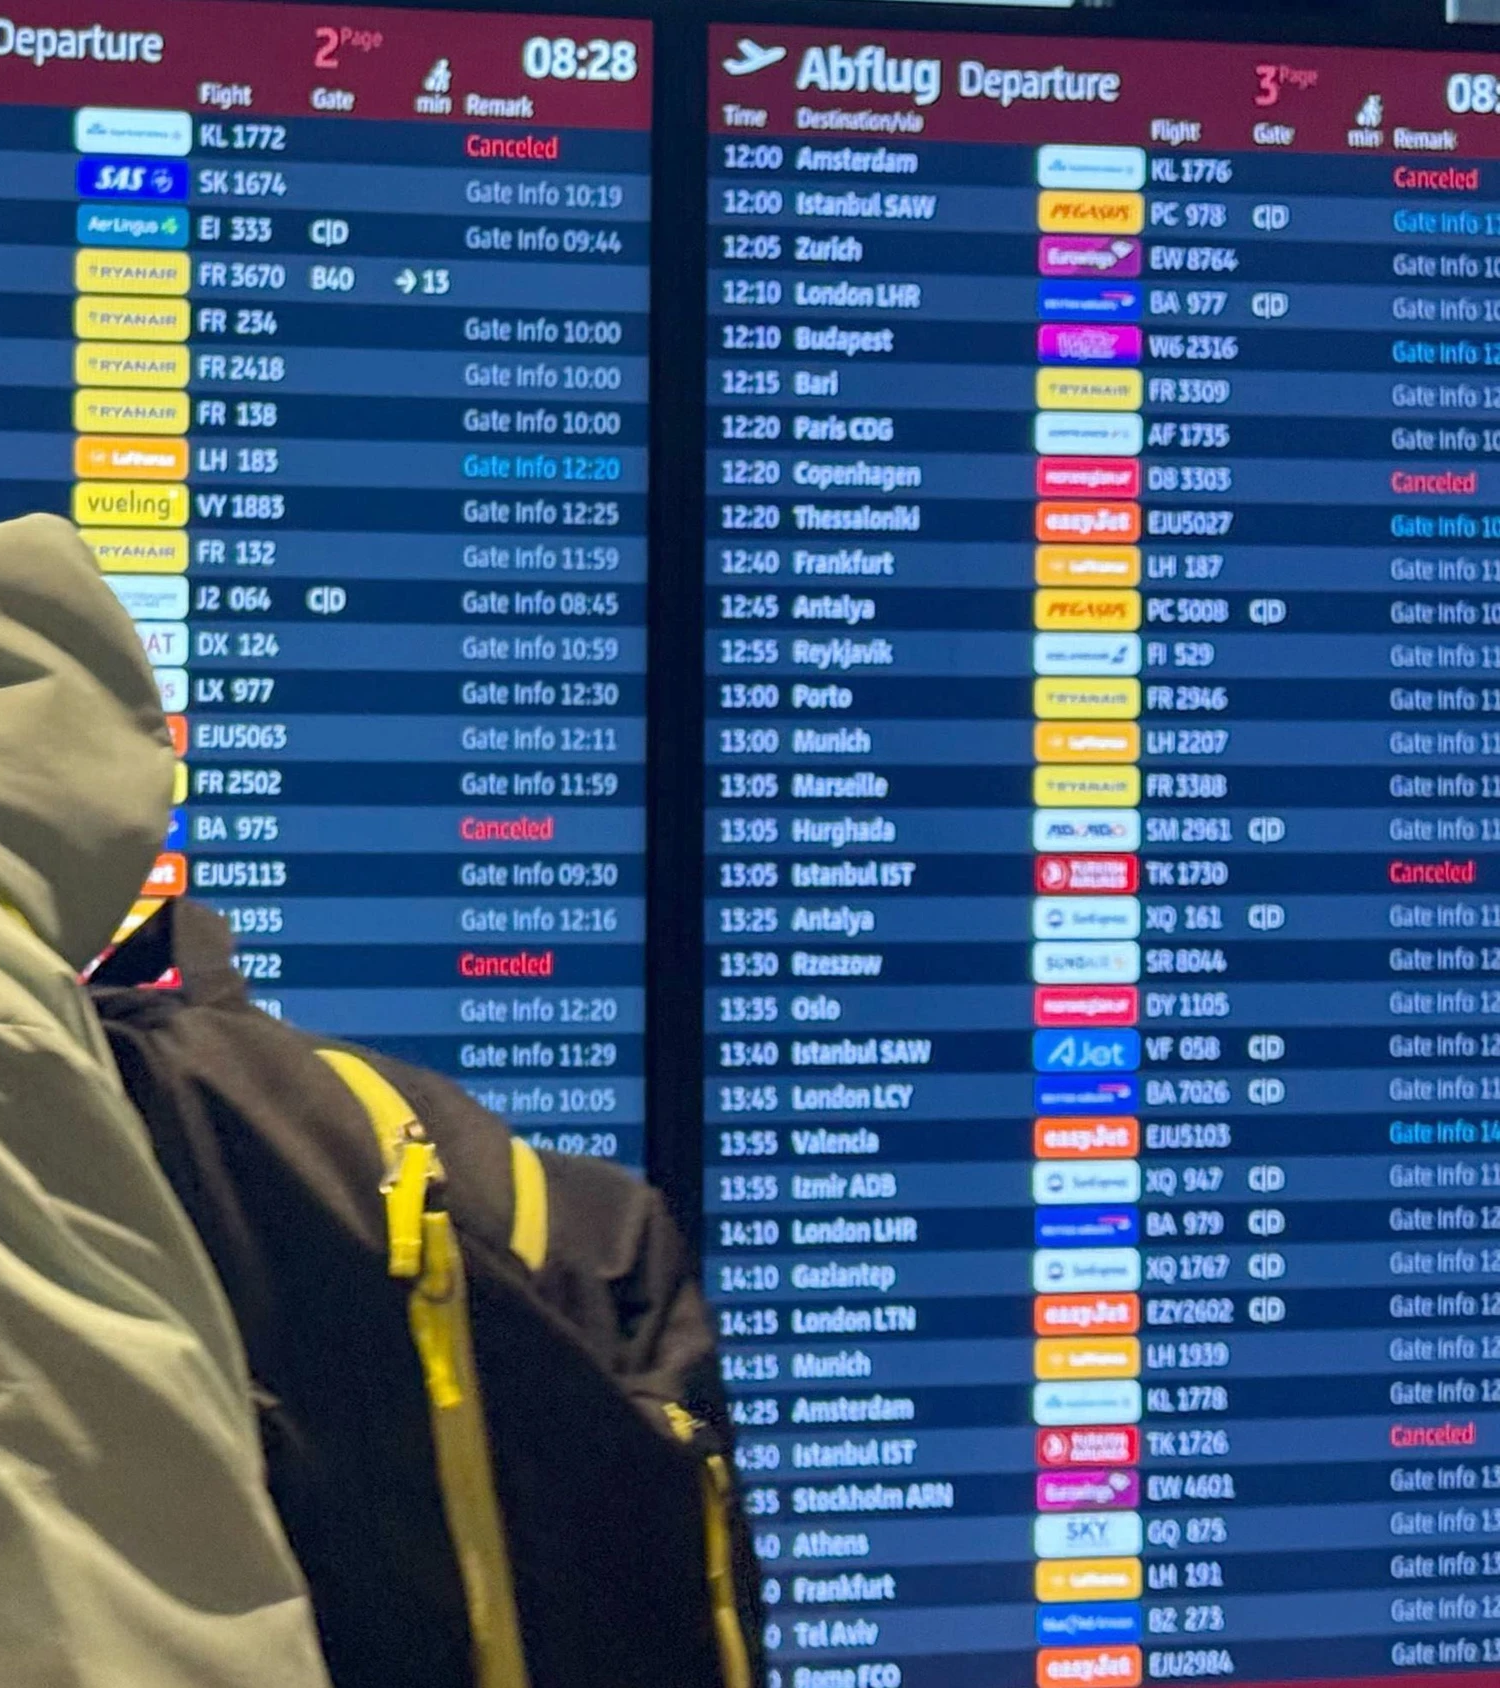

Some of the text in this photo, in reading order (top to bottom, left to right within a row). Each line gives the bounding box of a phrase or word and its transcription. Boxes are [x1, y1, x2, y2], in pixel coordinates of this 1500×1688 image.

[314, 26, 339, 68] 2
[341, 27, 384, 51] Page
[523, 36, 637, 82] 08:28
[795, 44, 1282, 108] Abflug Departure 3
[199, 82, 252, 110] Flight
[311, 87, 355, 111] Gate
[416, 93, 452, 114] min
[465, 93, 534, 118] Remark
[199, 123, 229, 148] KL
[232, 123, 286, 151] 1772
[464, 134, 560, 160] Canceled
[724, 143, 1479, 190] 12:00 Amsterdam KL 1776 Canceled
[94, 165, 147, 191] SAS
[199, 169, 229, 194] SK
[233, 170, 287, 196] 1674
[465, 180, 513, 205] Gate
[518, 180, 560, 206] Info
[565, 184, 623, 209] 10:19
[723, 189, 783, 215] 12:00
[795, 191, 883, 217] Istanbul
[883, 194, 936, 219] SAW
[1150, 201, 1179, 226] PC
[1184, 202, 1227, 228] 978
[198, 215, 221, 241] EI
[230, 216, 272, 243] 333
[465, 225, 513, 250] Gate
[517, 226, 560, 252] Info
[562, 229, 622, 254] 09:44
[723, 234, 1239, 272] 12:05 Zurich EW 8764
[99, 265, 178, 280] RYANAIR
[198, 261, 227, 287] FR
[230, 262, 286, 289] 3670
[310, 265, 355, 291] B40
[422, 269, 450, 294] 13
[723, 279, 1228, 316] 12:10 London LHR BA 977
[99, 312, 178, 327] RYANAIR
[197, 307, 227, 333] FR
[235, 309, 278, 335] 234
[464, 317, 512, 342] Gate
[516, 317, 559, 343] Info
[563, 320, 622, 345] 10:00
[87, 489, 285, 521] vueling VY 1883
[791, 683, 853, 709] Porto
[195, 723, 287, 749] EJU5063
[720, 727, 1229, 754] 13:00 Munich LH 2207
[195, 815, 554, 841] BA 975 Canceled
[720, 1261, 896, 1292] 14:10 Gaziantep
